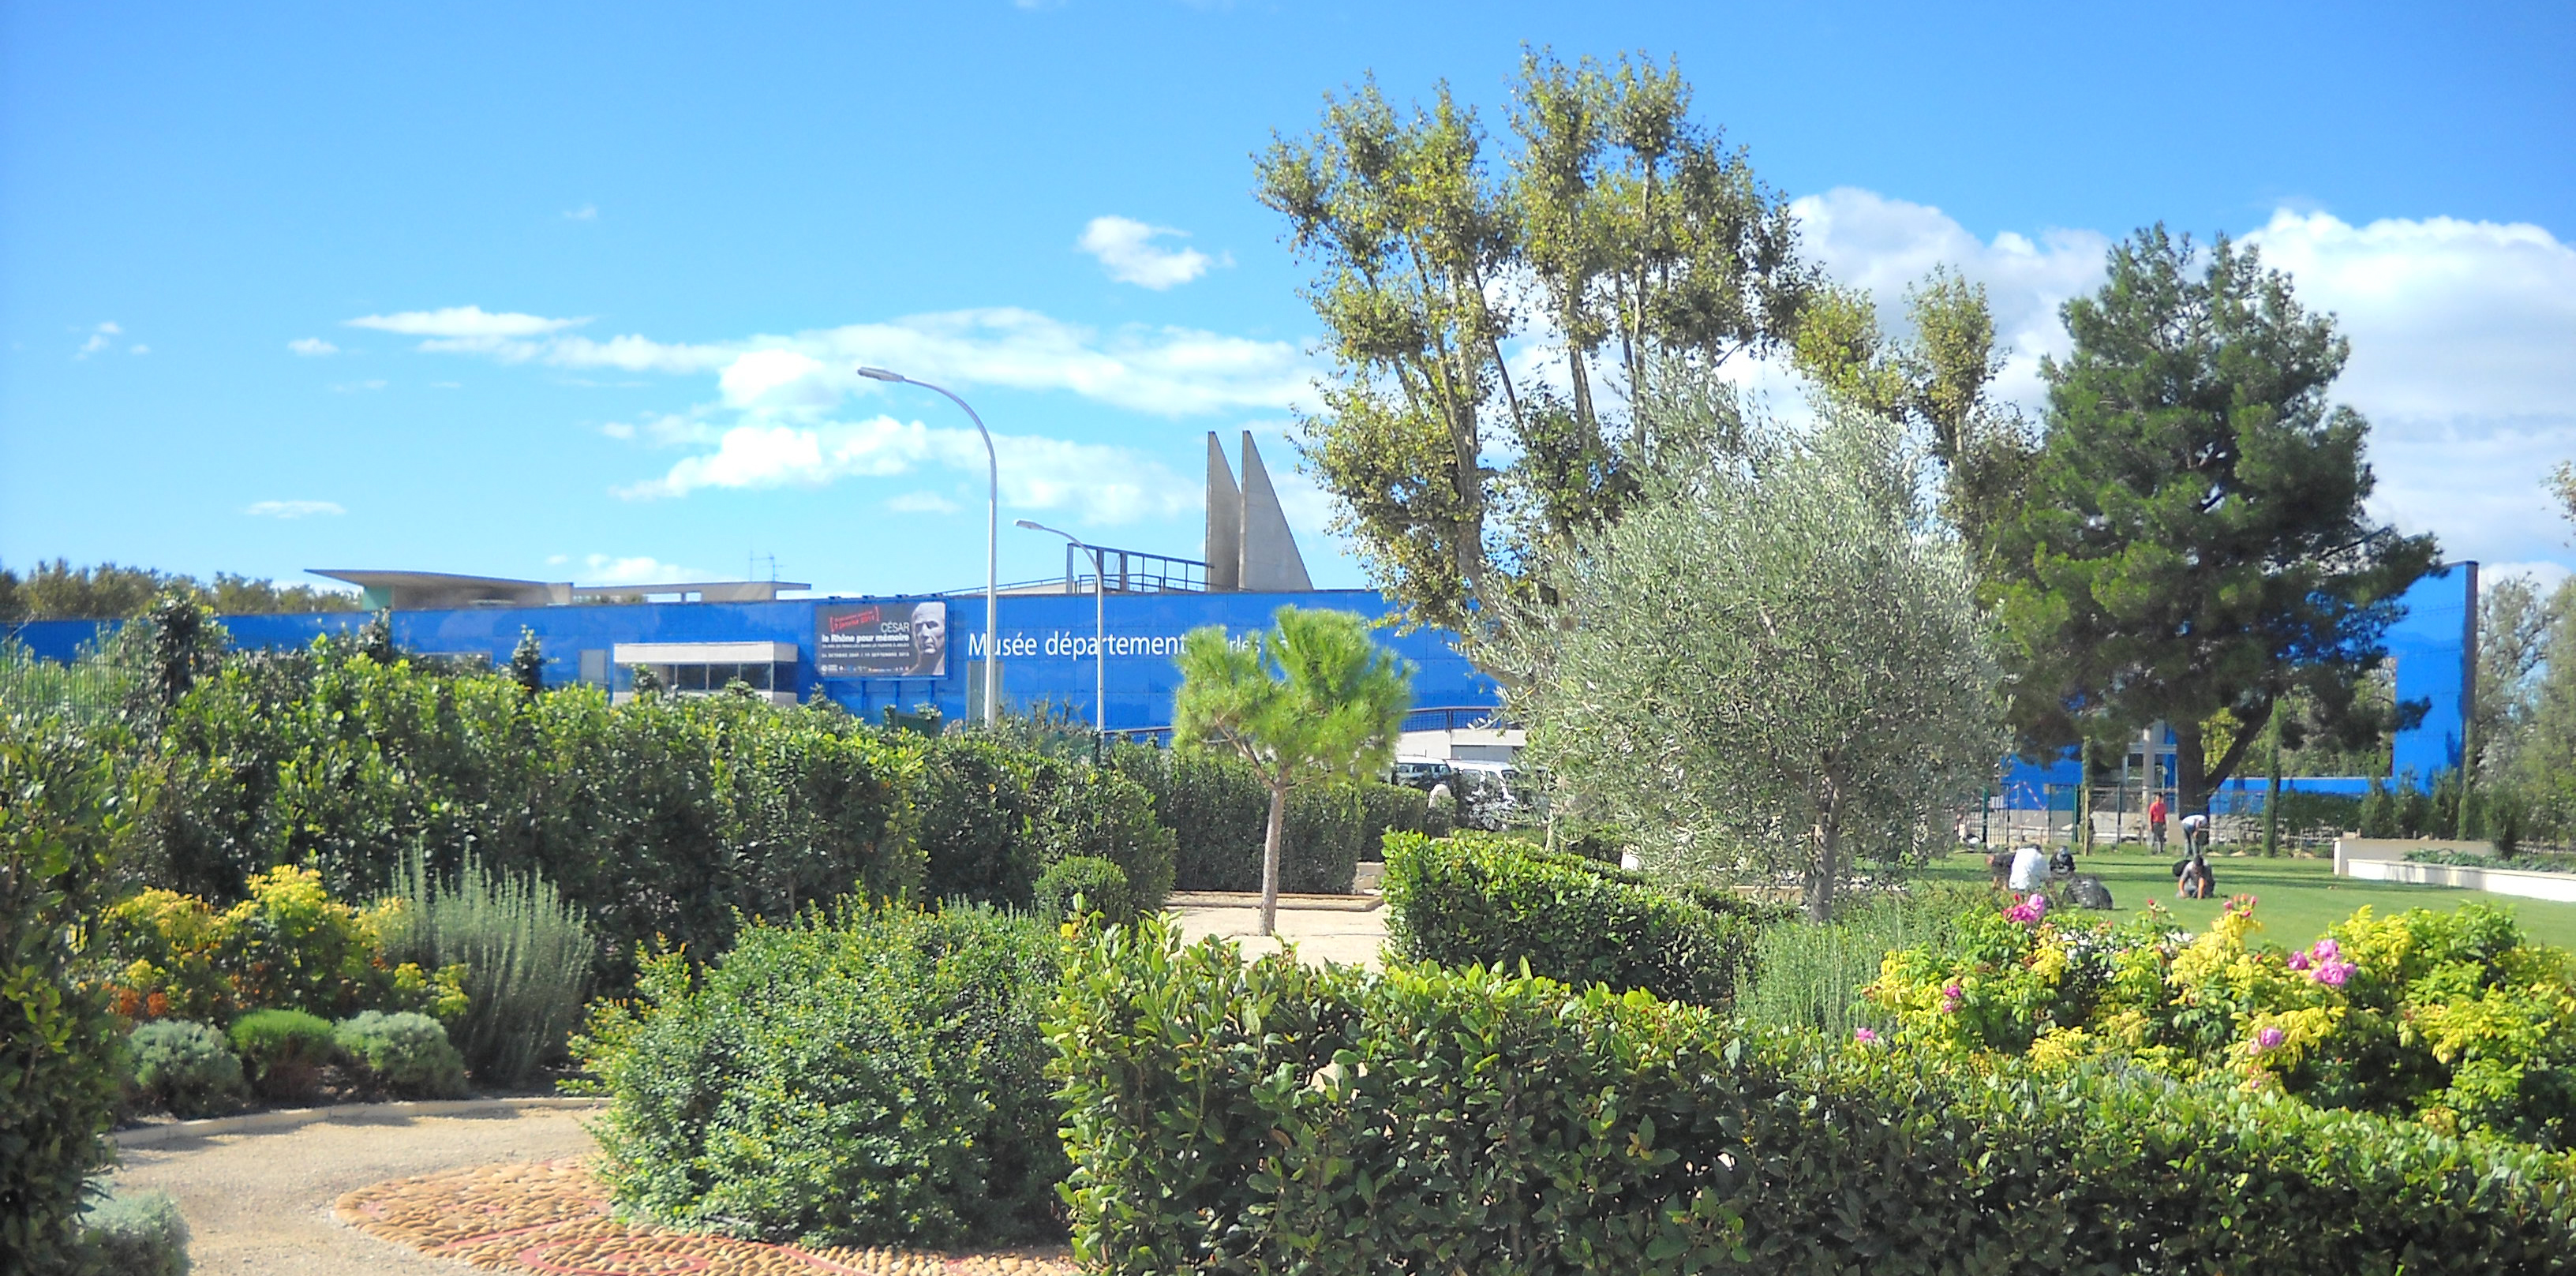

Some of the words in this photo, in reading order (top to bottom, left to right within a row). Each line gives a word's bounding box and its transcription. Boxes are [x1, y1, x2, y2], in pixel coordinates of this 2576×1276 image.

[881, 620, 910, 633] CÉSAR
[822, 634, 829, 643] le
[831, 634, 856, 642] Rhône
[856, 634, 874, 644] pour
[875, 633, 910, 642] mémoire
[1045, 631, 1187, 661] dépatement
[1229, 634, 1261, 654] rles
